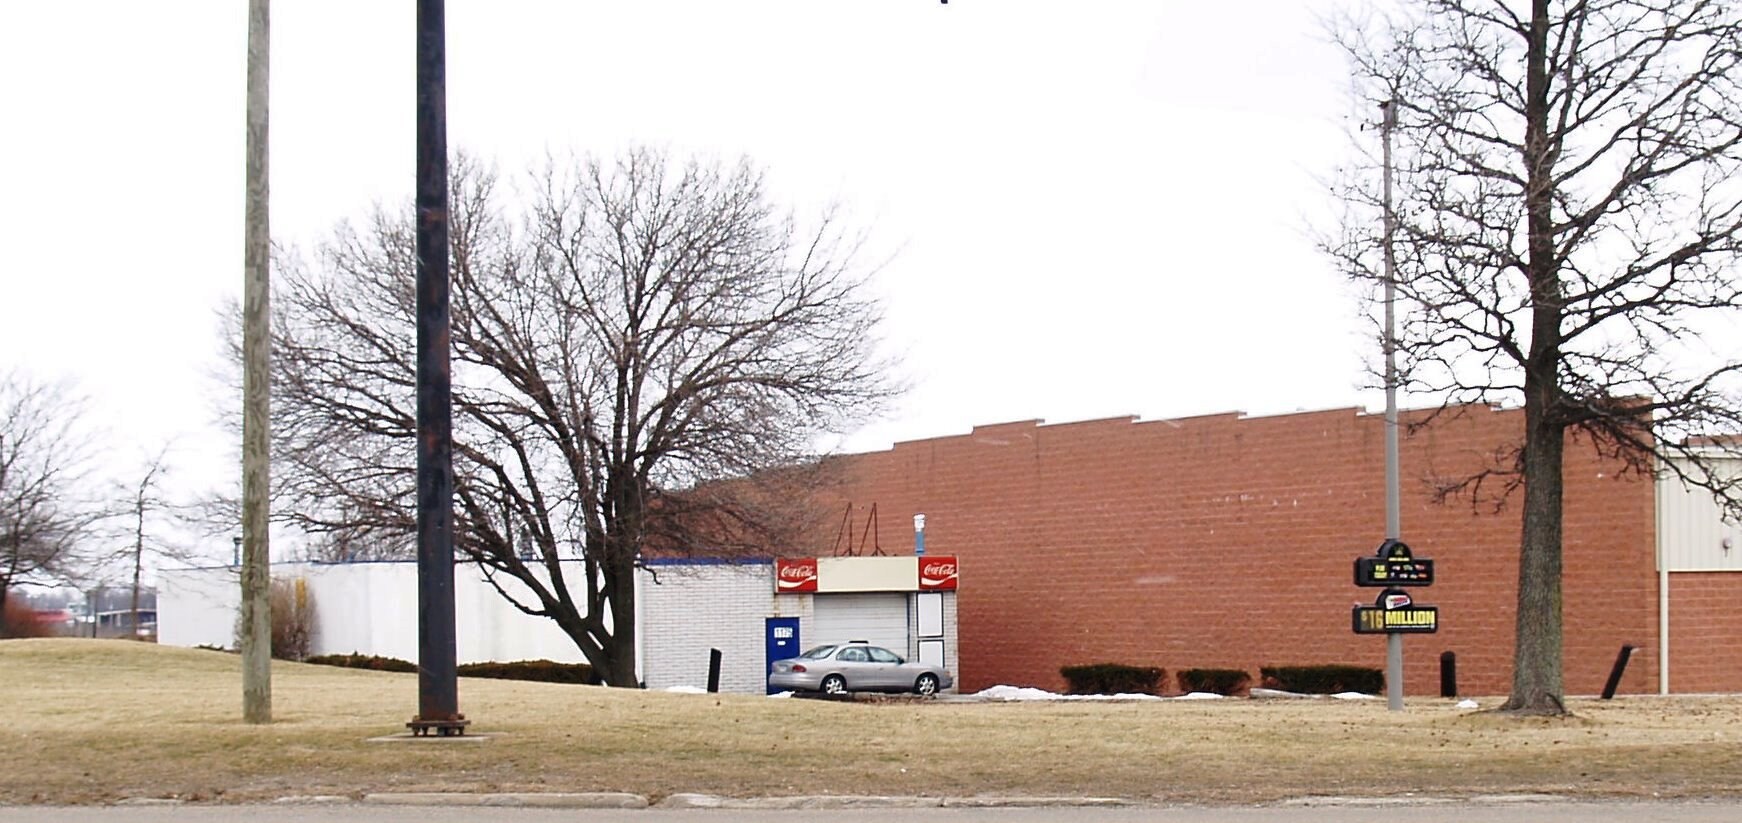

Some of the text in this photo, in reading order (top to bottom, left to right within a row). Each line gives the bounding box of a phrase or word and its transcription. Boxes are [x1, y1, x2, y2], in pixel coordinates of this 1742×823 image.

[780, 564, 813, 579] Coca-Cola
[924, 563, 955, 577] Coca-Cola
[1385, 611, 1435, 625] MILLION
